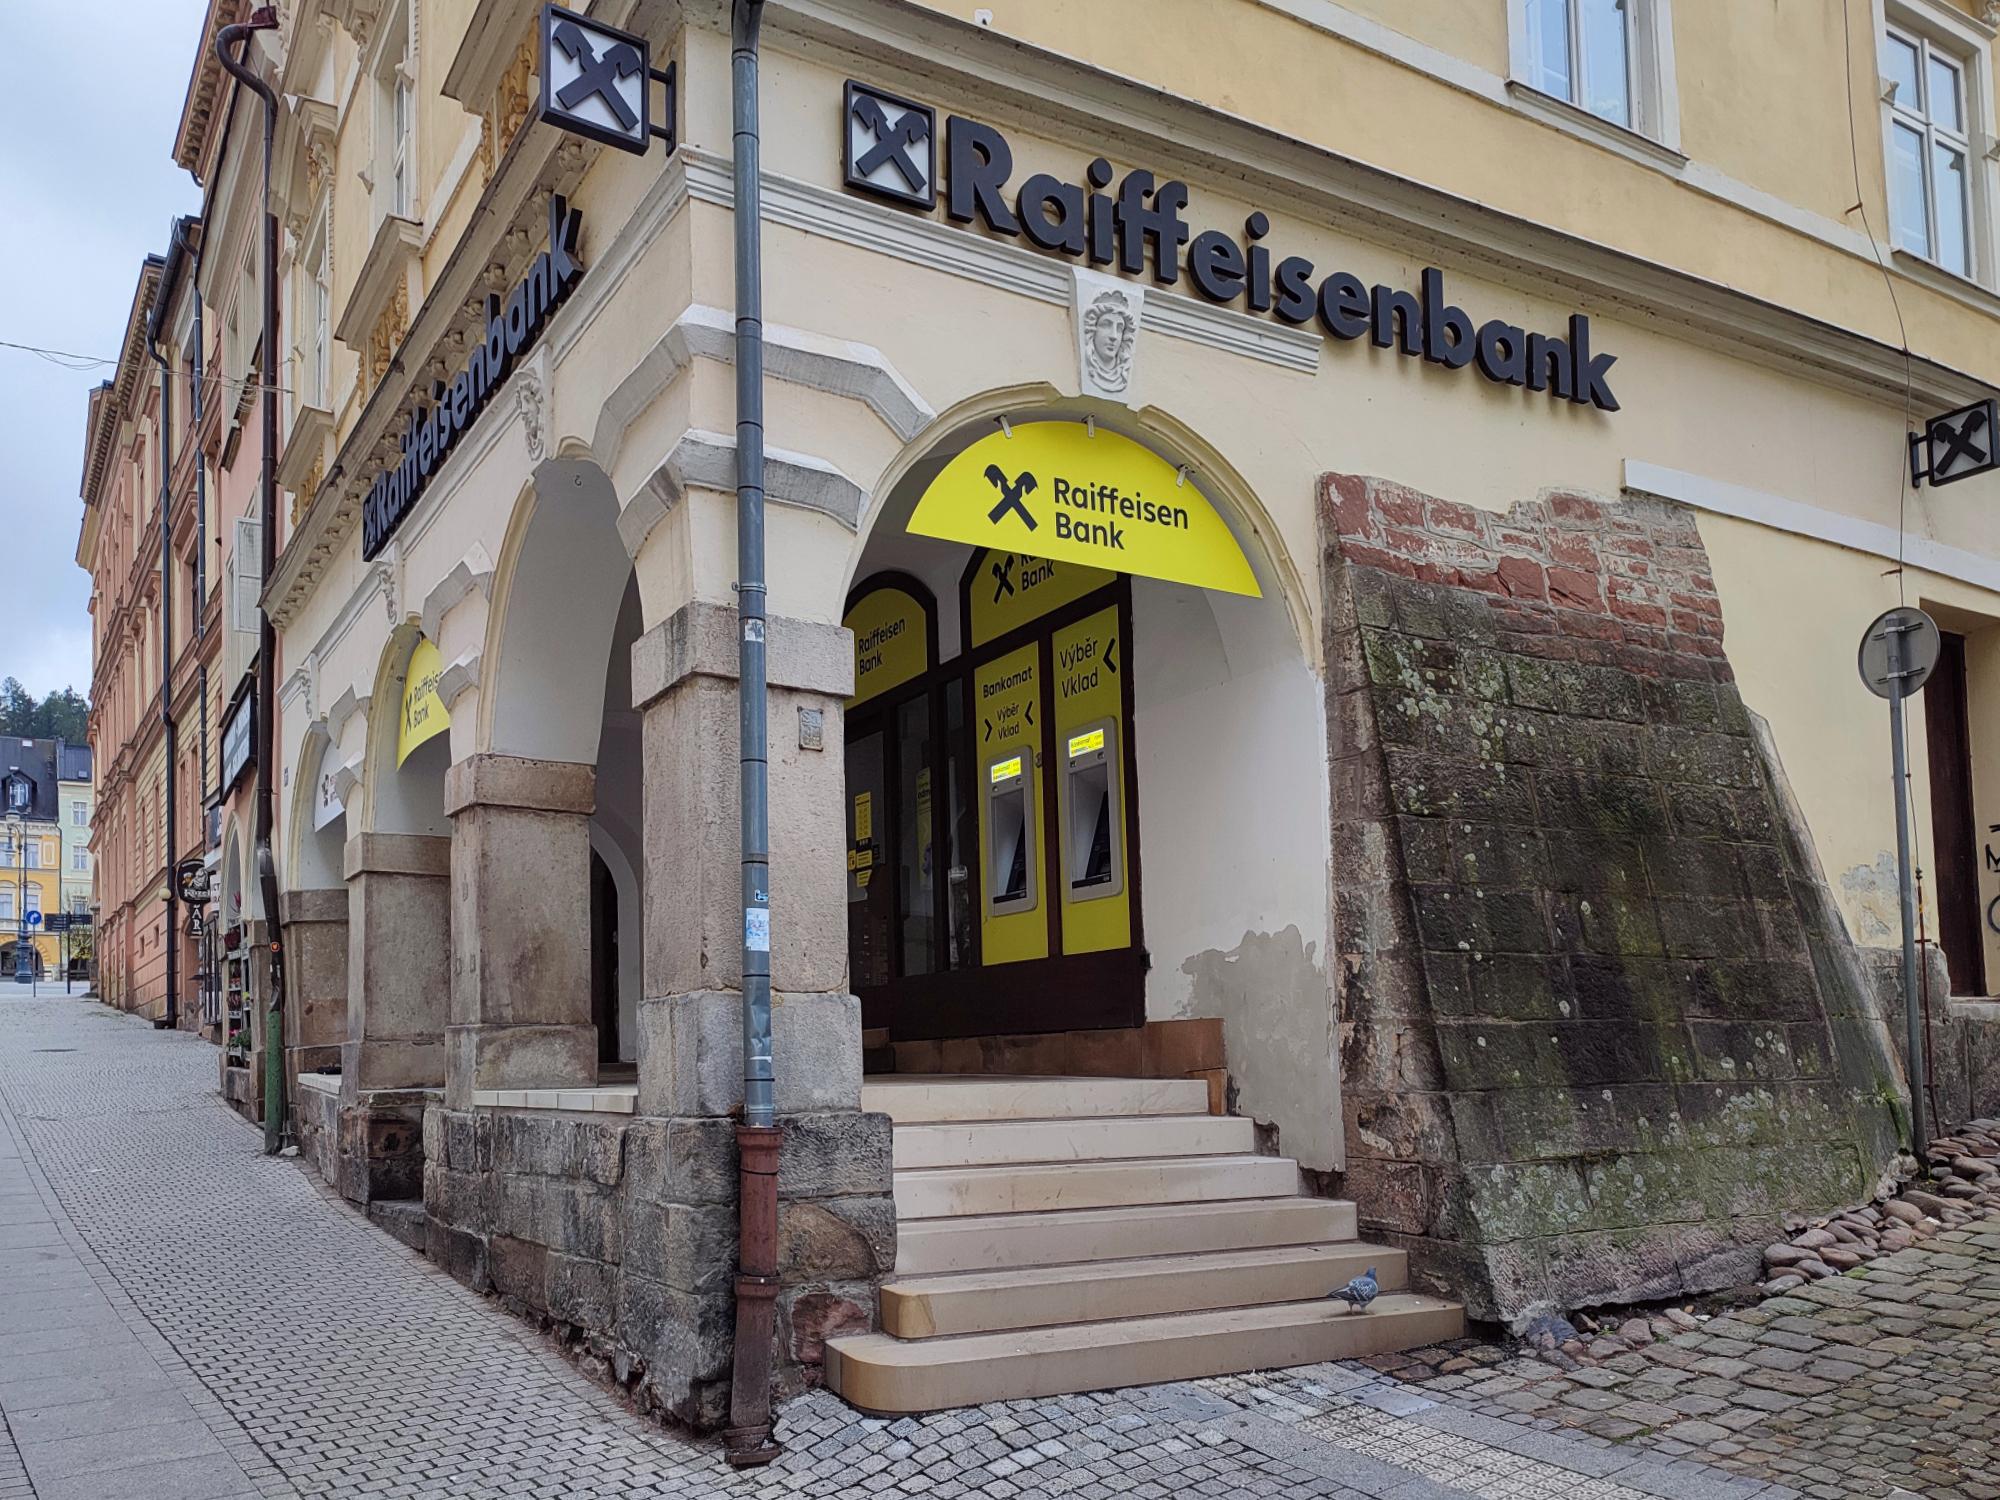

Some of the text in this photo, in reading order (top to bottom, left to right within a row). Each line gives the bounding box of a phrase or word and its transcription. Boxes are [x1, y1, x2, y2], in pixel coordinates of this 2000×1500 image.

[945, 113, 1621, 412] Raiffeisenbank
[374, 193, 584, 538] Raiffeisenbank
[1053, 476, 1188, 529] Raiffeisen
[1055, 511, 1125, 550] Bank
[1021, 559, 1054, 592] Bank
[858, 618, 906, 656] Raiffeisen
[1060, 636, 1098, 672] Výběr
[859, 649, 883, 676] Bank
[413, 670, 444, 704] Raiffeis
[983, 665, 1033, 698] Bankomat
[1062, 666, 1099, 699] Vklad
[998, 721, 1020, 741] Vklad
